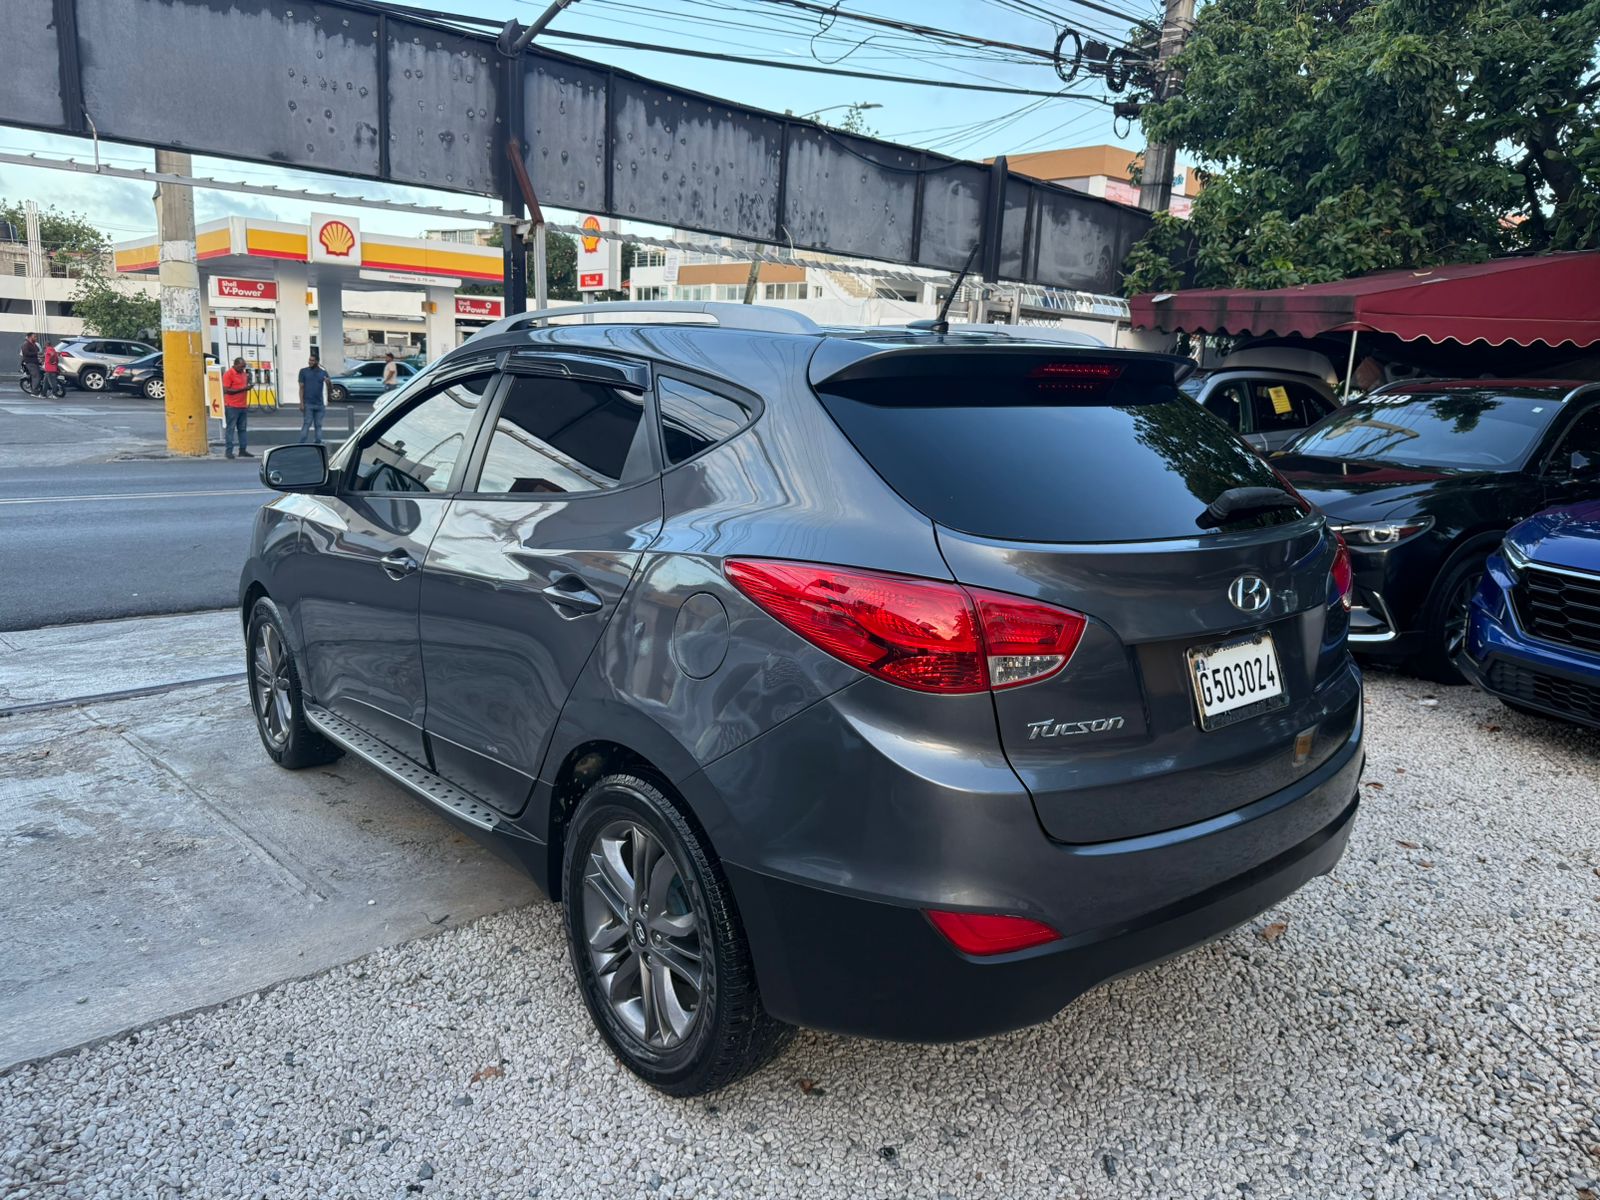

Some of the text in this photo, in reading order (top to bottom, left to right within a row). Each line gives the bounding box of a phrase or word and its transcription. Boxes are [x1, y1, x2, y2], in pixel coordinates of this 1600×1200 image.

[223, 286, 262, 296] V-Power
[459, 305, 490, 314] V-Power
[1358, 395, 1412, 404] 2019
[1200, 654, 1275, 706] G503024
